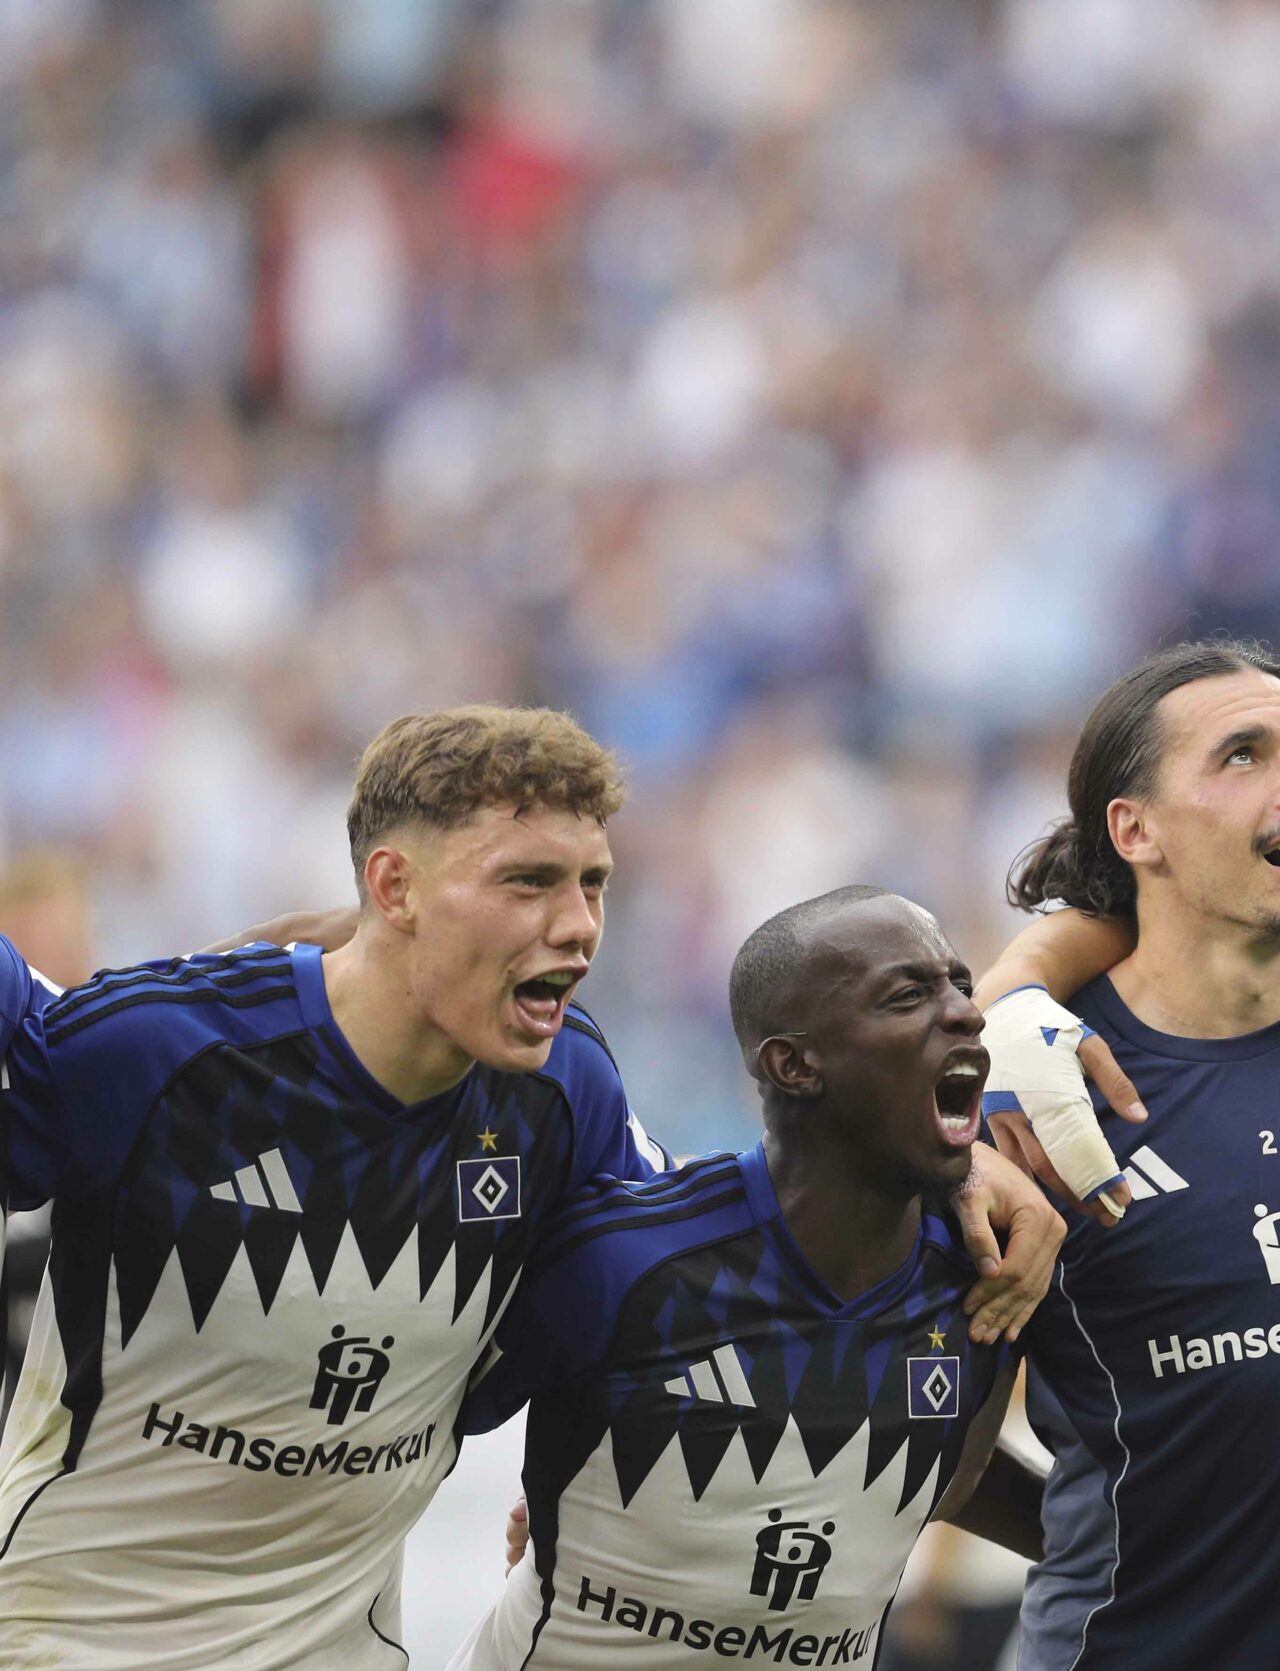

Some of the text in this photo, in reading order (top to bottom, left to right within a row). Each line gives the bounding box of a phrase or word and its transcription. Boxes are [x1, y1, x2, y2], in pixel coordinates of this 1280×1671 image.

[1258, 1130, 1278, 1155] 2
[142, 1402, 438, 1477] HanseMerkur
[576, 1576, 879, 1668] HanseMerkur
